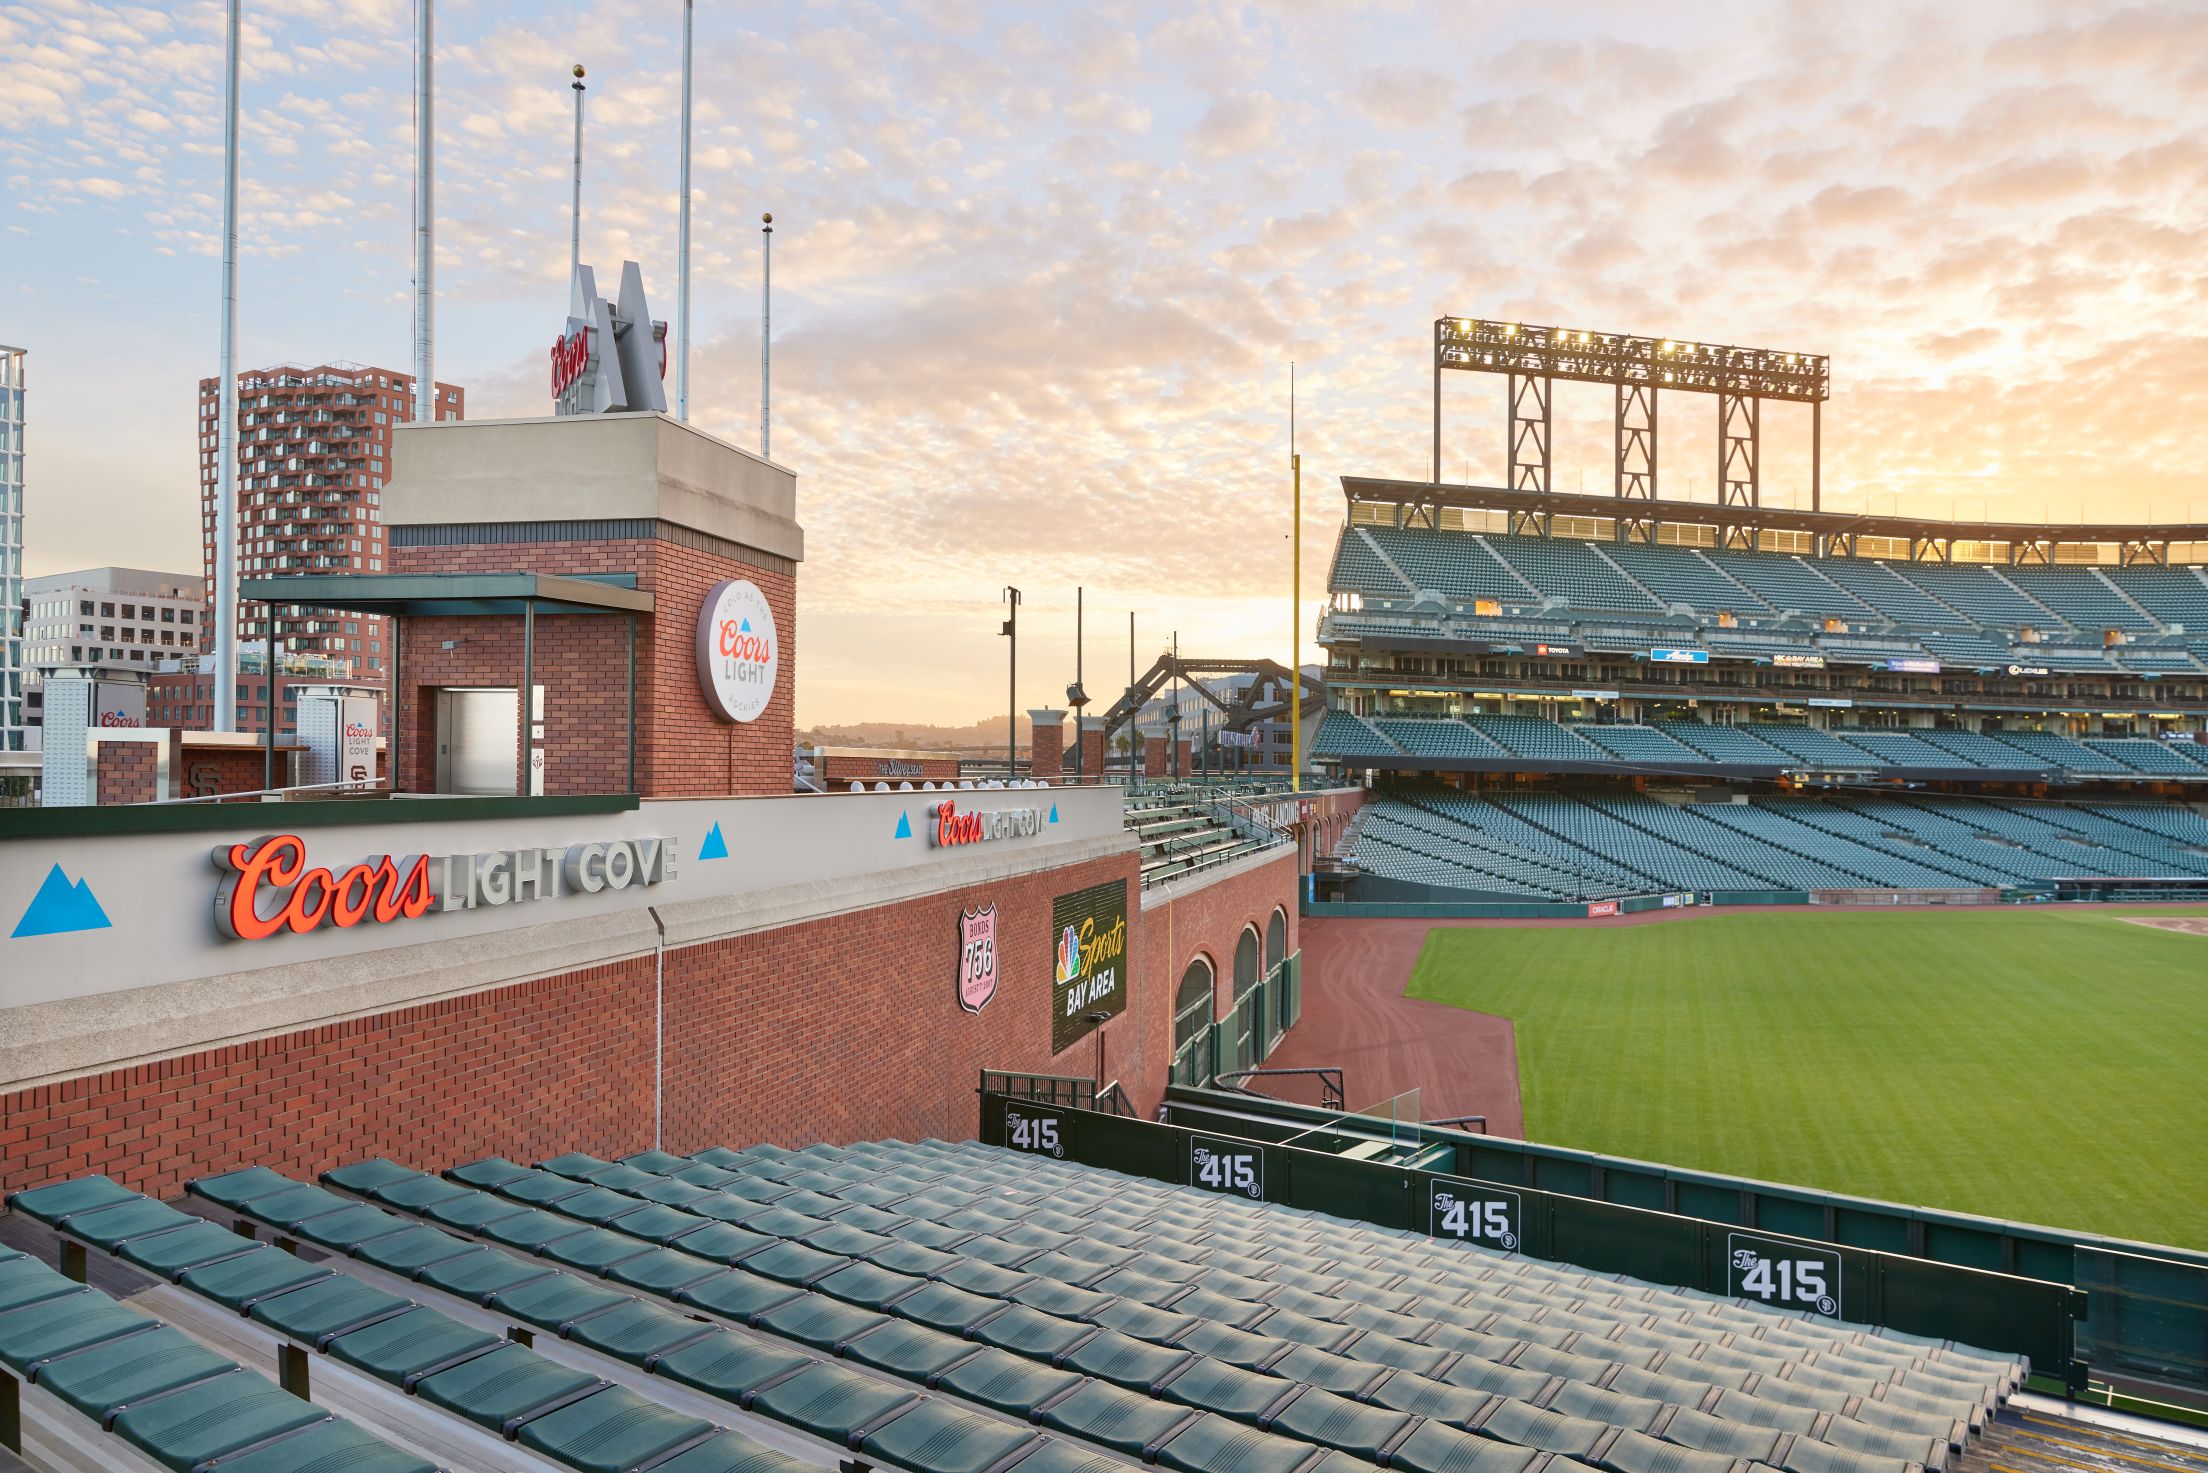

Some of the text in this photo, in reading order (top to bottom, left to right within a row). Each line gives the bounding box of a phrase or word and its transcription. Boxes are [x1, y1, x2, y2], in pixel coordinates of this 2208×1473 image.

[724, 592, 741, 613] COLD
[720, 619, 770, 664] Coors
[725, 659, 765, 685] LIGHT
[1804, 656, 1824, 664] AREA
[729, 695, 759, 712] ROCKIES
[101, 711, 141, 728] Coors
[346, 723, 373, 738] Coors
[349, 747, 369, 755] COVE
[938, 800, 1046, 847] Coors LIGHT COVE
[228, 834, 678, 940] Coors LIGHT COVE
[1592, 905, 1613, 913] ORACLE
[969, 920, 989, 938] BONDS
[965, 936, 993, 983] 756
[1080, 914, 1125, 983] Sports
[1067, 967, 1115, 1017] BAY AREA
[1012, 1119, 1059, 1149] 415
[1194, 1148, 1211, 1165] The
[1199, 1155, 1254, 1188] 415
[1434, 1193, 1455, 1212] The
[1441, 1201, 1509, 1238] 415
[1732, 1249, 1758, 1271] The
[1741, 1259, 1826, 1302] 415
